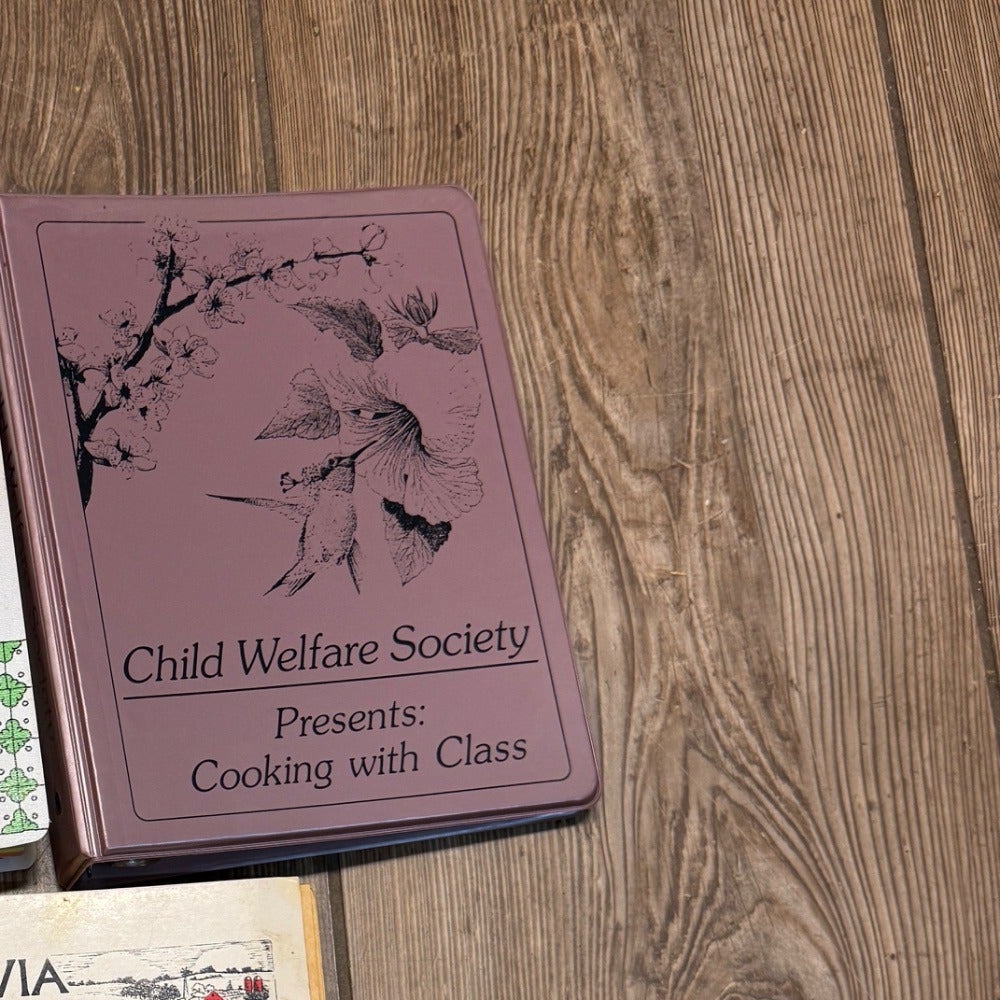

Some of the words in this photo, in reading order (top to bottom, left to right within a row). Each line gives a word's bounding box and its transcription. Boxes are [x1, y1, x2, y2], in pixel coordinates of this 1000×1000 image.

[123, 641, 225, 684] Child
[237, 633, 379, 675] Welfare
[390, 620, 530, 662] Society
[275, 701, 425, 739] Presents:
[191, 754, 333, 792] Cooking
[350, 741, 419, 779] with
[436, 734, 528, 768] Class
